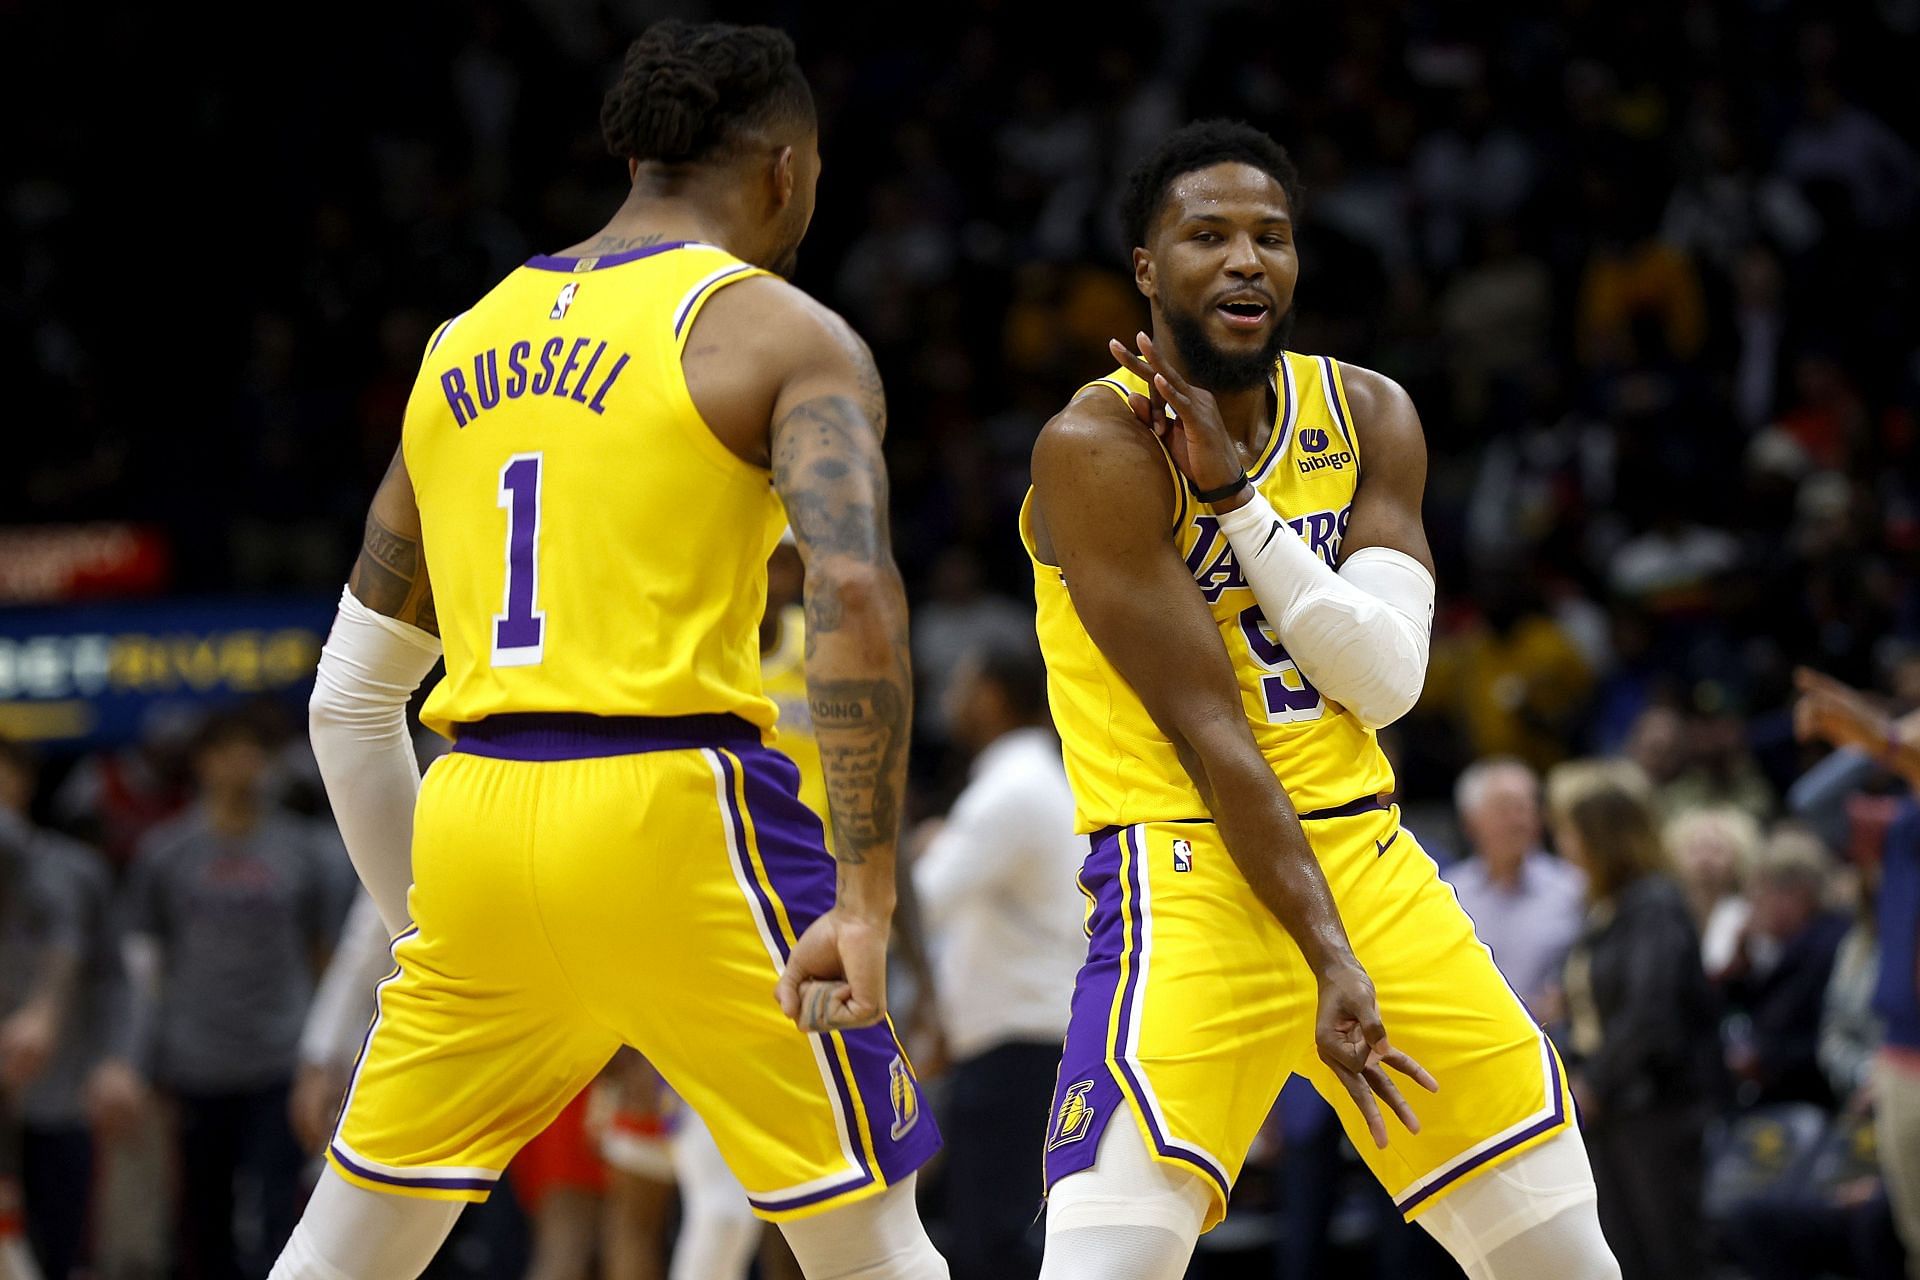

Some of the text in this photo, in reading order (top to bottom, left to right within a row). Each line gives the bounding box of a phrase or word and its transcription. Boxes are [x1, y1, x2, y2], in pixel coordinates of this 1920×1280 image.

[441, 337, 631, 429] RUSSELL
[1297, 451, 1351, 474] bibigo
[490, 451, 546, 667] 1
